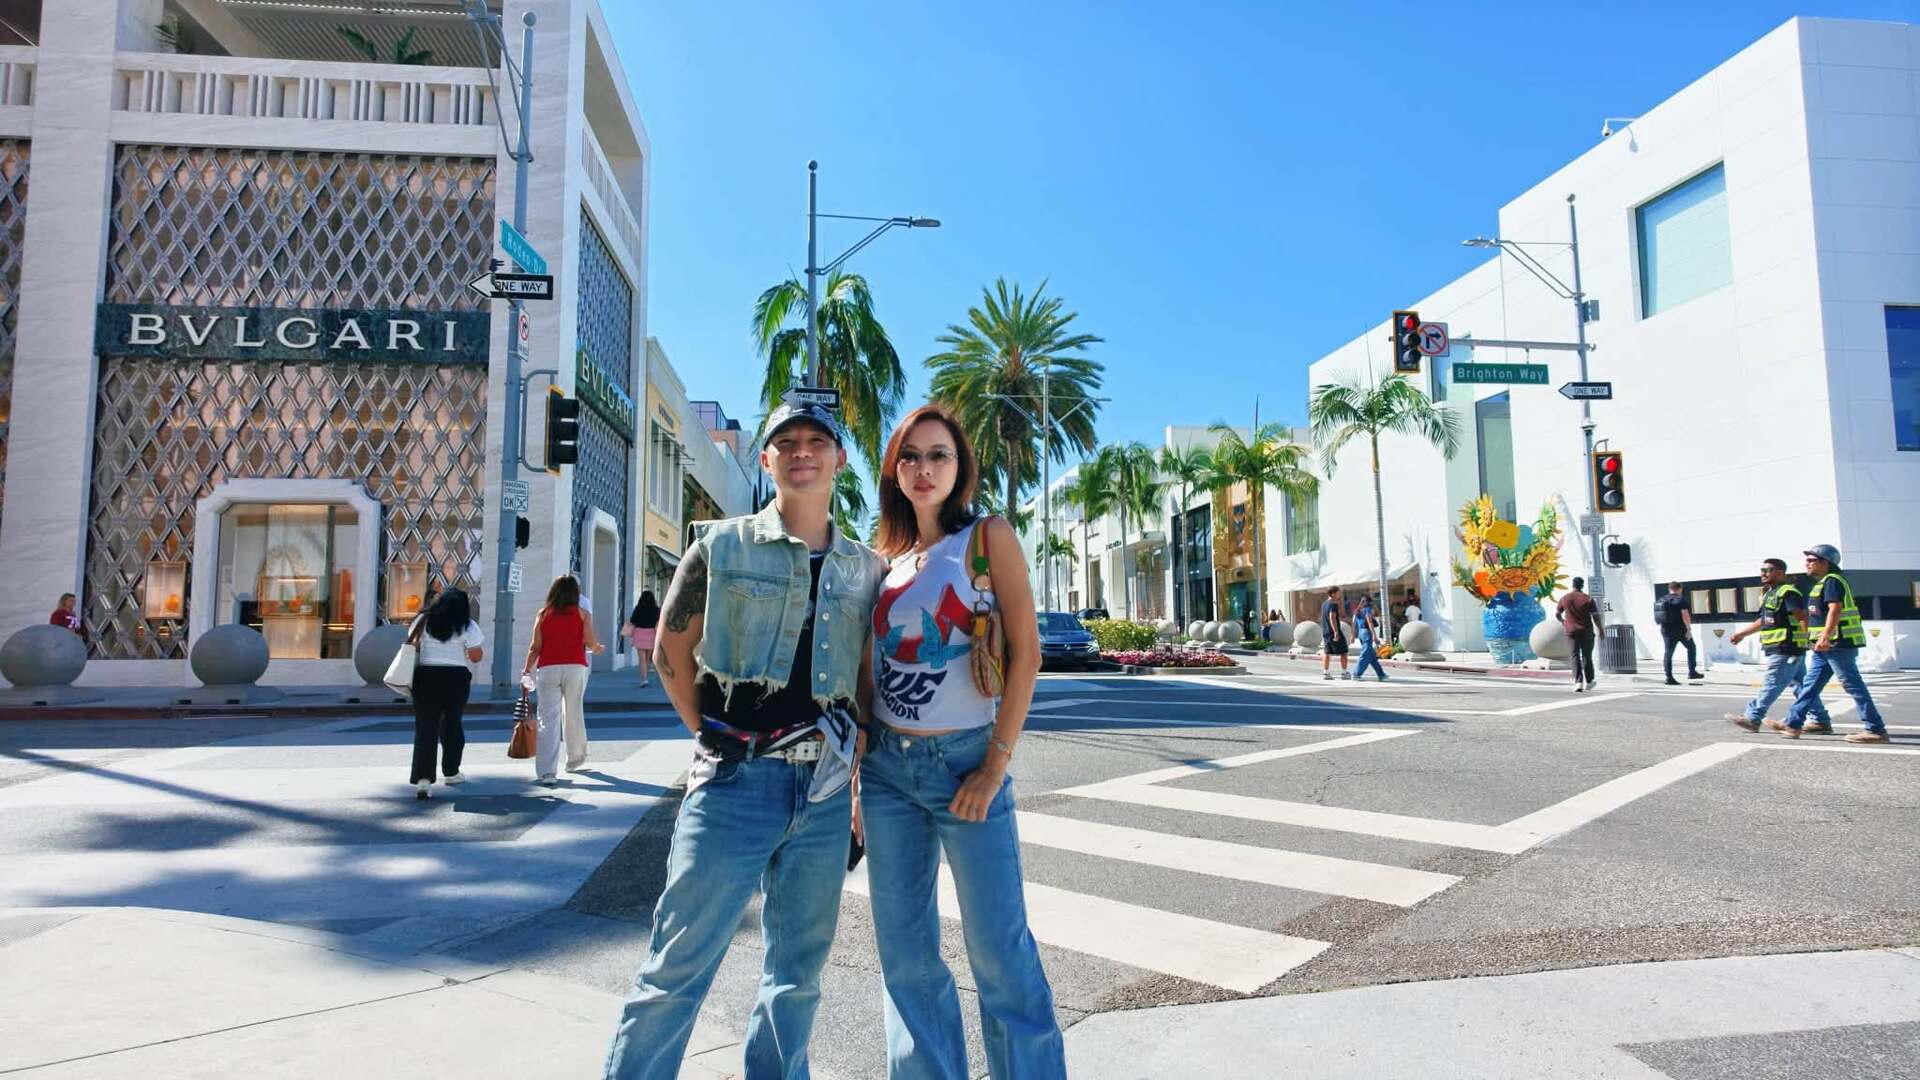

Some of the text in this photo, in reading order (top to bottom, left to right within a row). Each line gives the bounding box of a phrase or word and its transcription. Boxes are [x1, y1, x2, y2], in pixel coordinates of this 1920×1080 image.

[520, 281, 543, 292] WAY
[128, 313, 457, 351] BVLGARI
[1457, 368, 1544, 382] Brighton Way
[581, 351, 635, 430] BVLGARI
[1574, 387, 1606, 395] ONE WAY
[815, 393, 833, 403] WAY
[503, 496, 514, 508] OK
